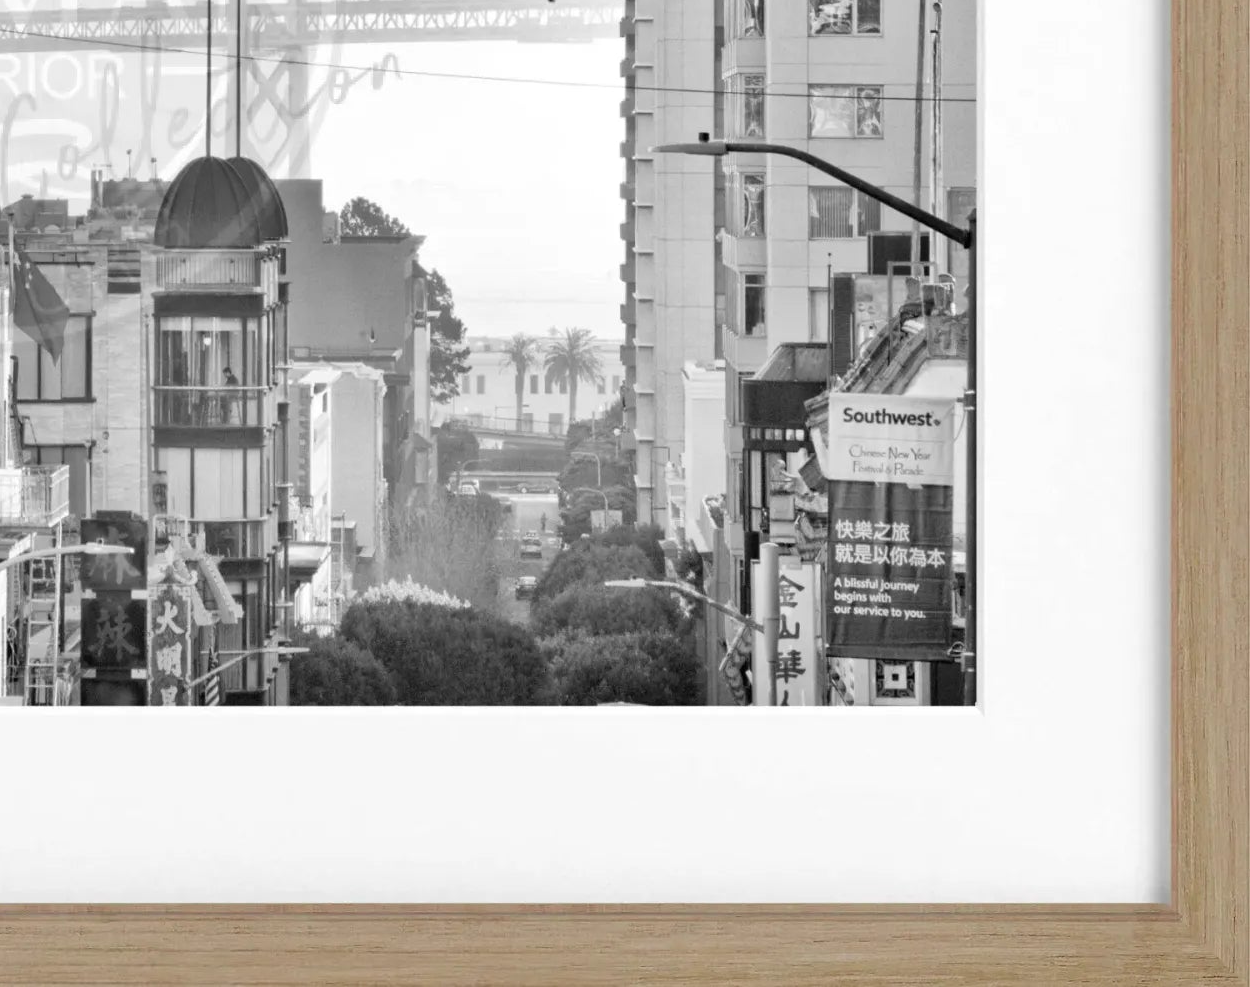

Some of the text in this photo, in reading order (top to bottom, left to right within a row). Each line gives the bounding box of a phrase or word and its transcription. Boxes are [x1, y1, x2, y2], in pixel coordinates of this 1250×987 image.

[843, 407, 933, 427] Southwest
[848, 444, 932, 460] Chinese New Year
[894, 462, 925, 476] Parade
[835, 519, 910, 542] 快樂之旅
[835, 543, 946, 568] 就是以你為本
[834, 577, 920, 594] A blissful journey
[834, 590, 892, 604] begins with
[834, 606, 926, 621] our service to you.
